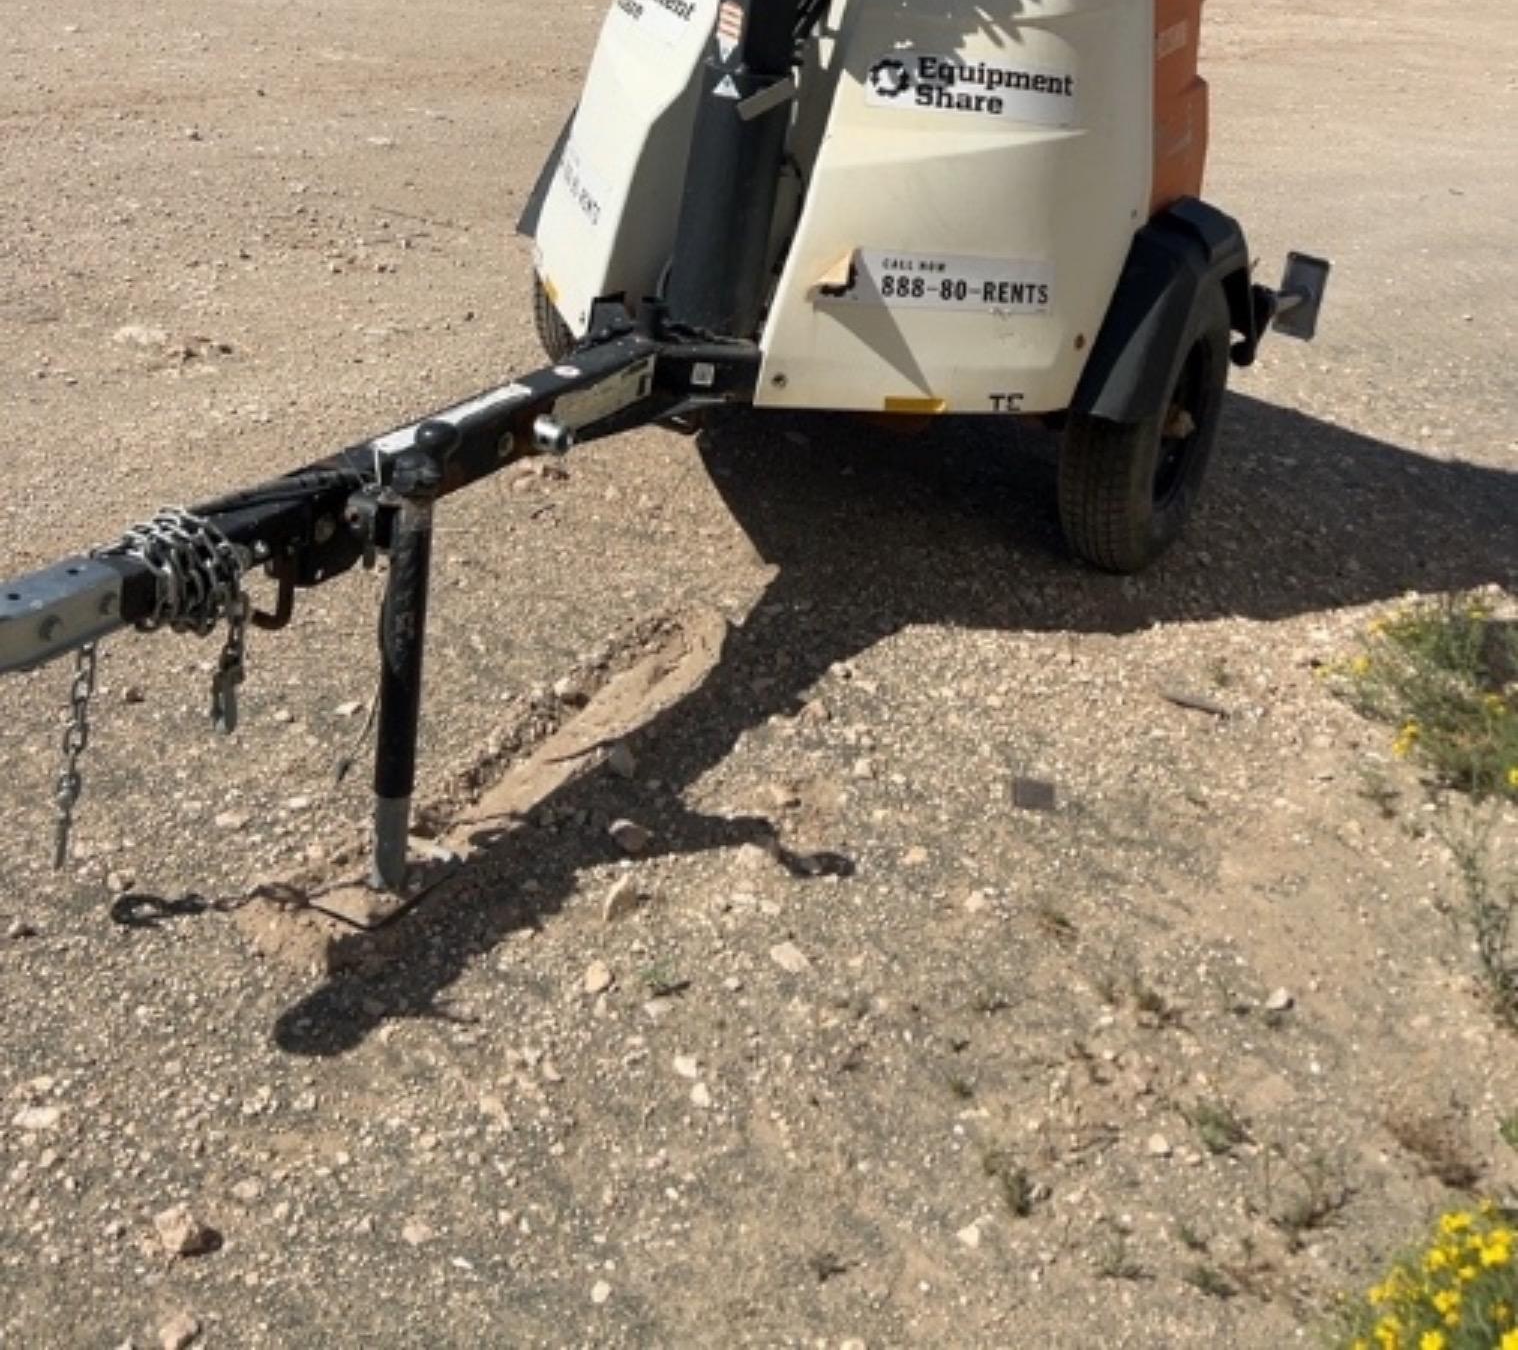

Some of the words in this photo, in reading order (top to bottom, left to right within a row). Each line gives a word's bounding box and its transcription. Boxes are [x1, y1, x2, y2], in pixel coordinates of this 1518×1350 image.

[915, 55, 1075, 97] Equipment
[914, 83, 1004, 115] Share
[881, 257, 914, 272] CALL
[918, 260, 947, 273] NOW
[880, 274, 1050, 305] 888-80-RENTS
